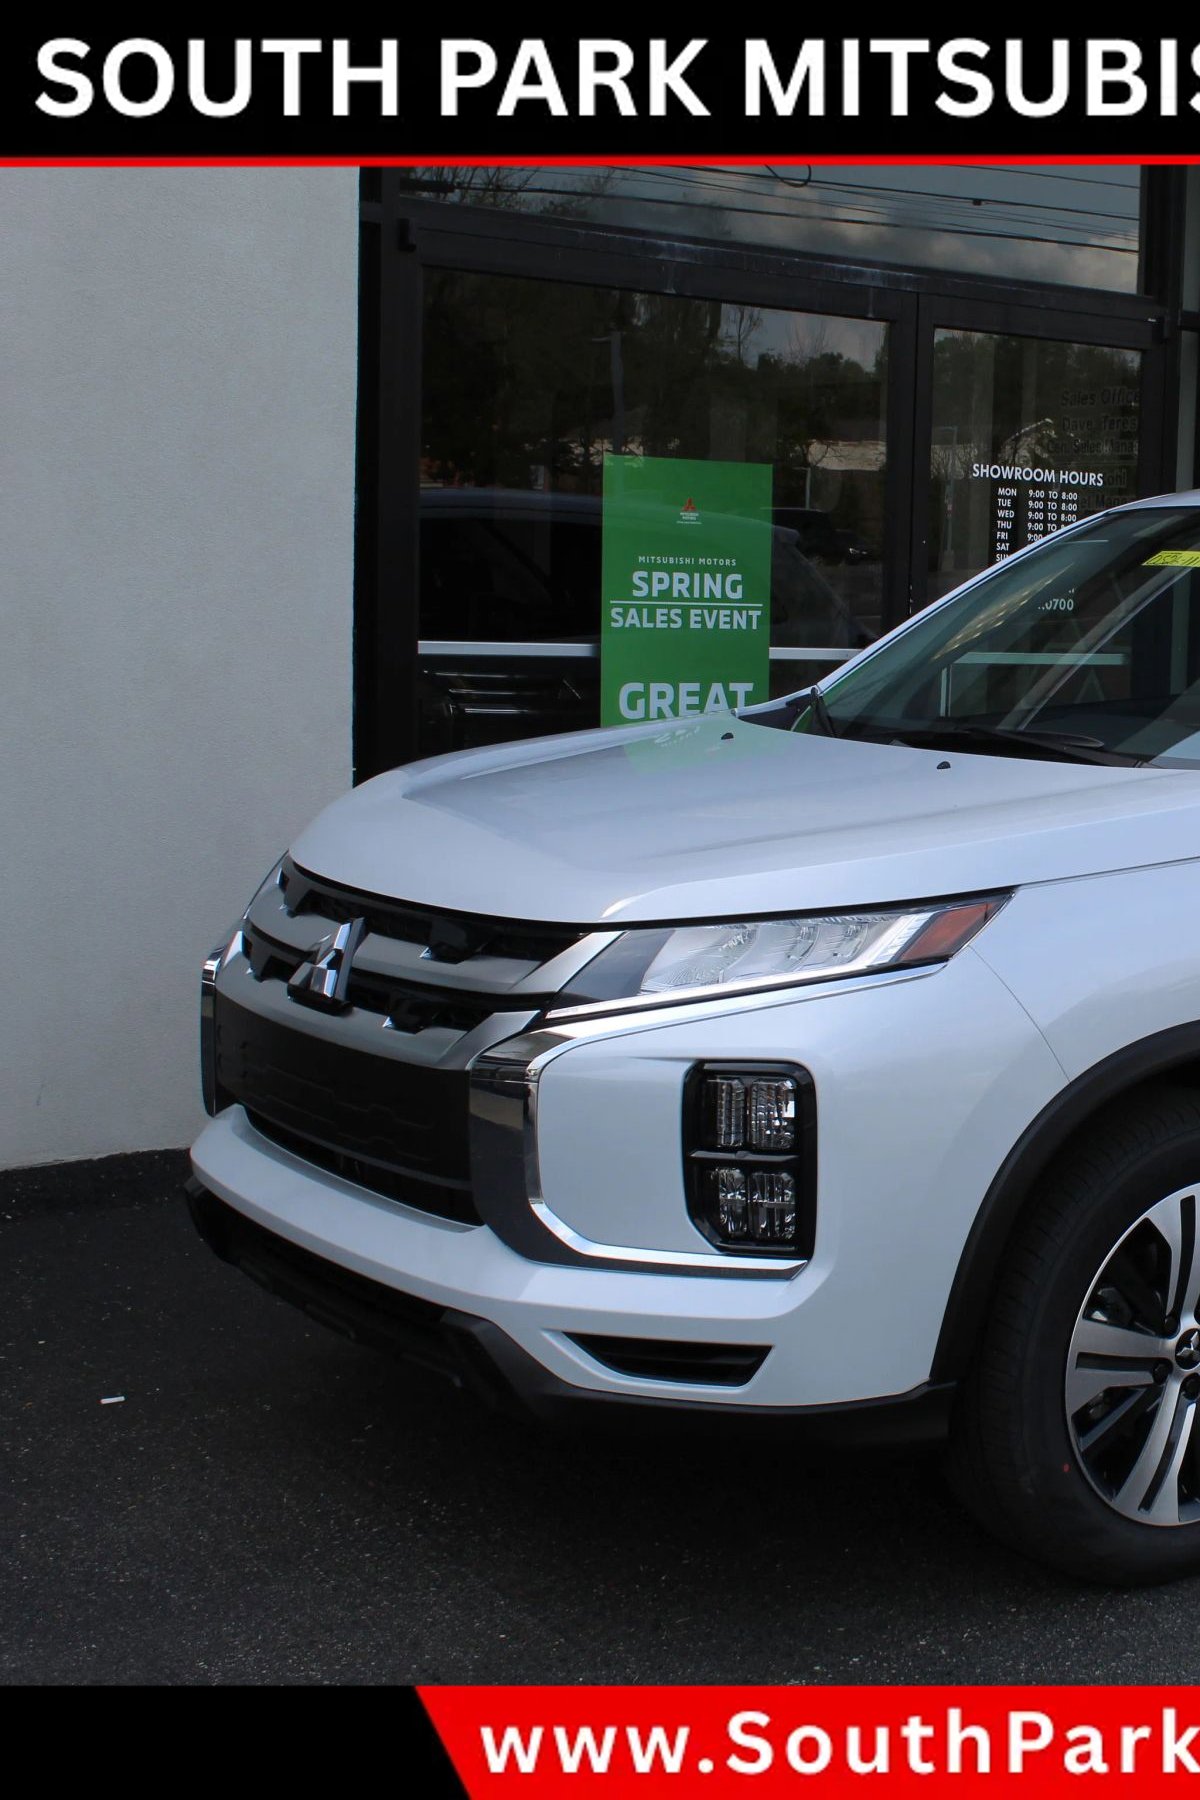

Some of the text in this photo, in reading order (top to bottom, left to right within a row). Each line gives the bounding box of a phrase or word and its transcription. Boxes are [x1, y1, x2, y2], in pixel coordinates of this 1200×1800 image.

[972, 463, 1104, 487] SHOWROOM HOURS
[997, 488, 1017, 497] MON
[1028, 490, 1045, 499] 9:00
[1048, 491, 1059, 500] TO
[1061, 492, 1078, 501] 8:00
[997, 498, 1078, 512] TUE 9:00 TO 8:00
[997, 509, 1077, 522] WED 9:00 TO 8:00
[996, 520, 1012, 529] THU
[1027, 522, 1044, 531] 9:00
[1046, 524, 1057, 532] TO
[996, 531, 1009, 540] FRI
[995, 542, 1010, 551] SAT
[638, 555, 737, 566] MITSUBISHI MOTORS
[631, 570, 743, 599] SPRING
[610, 607, 762, 630] SALES EVENT
[618, 682, 754, 720] GREAT
